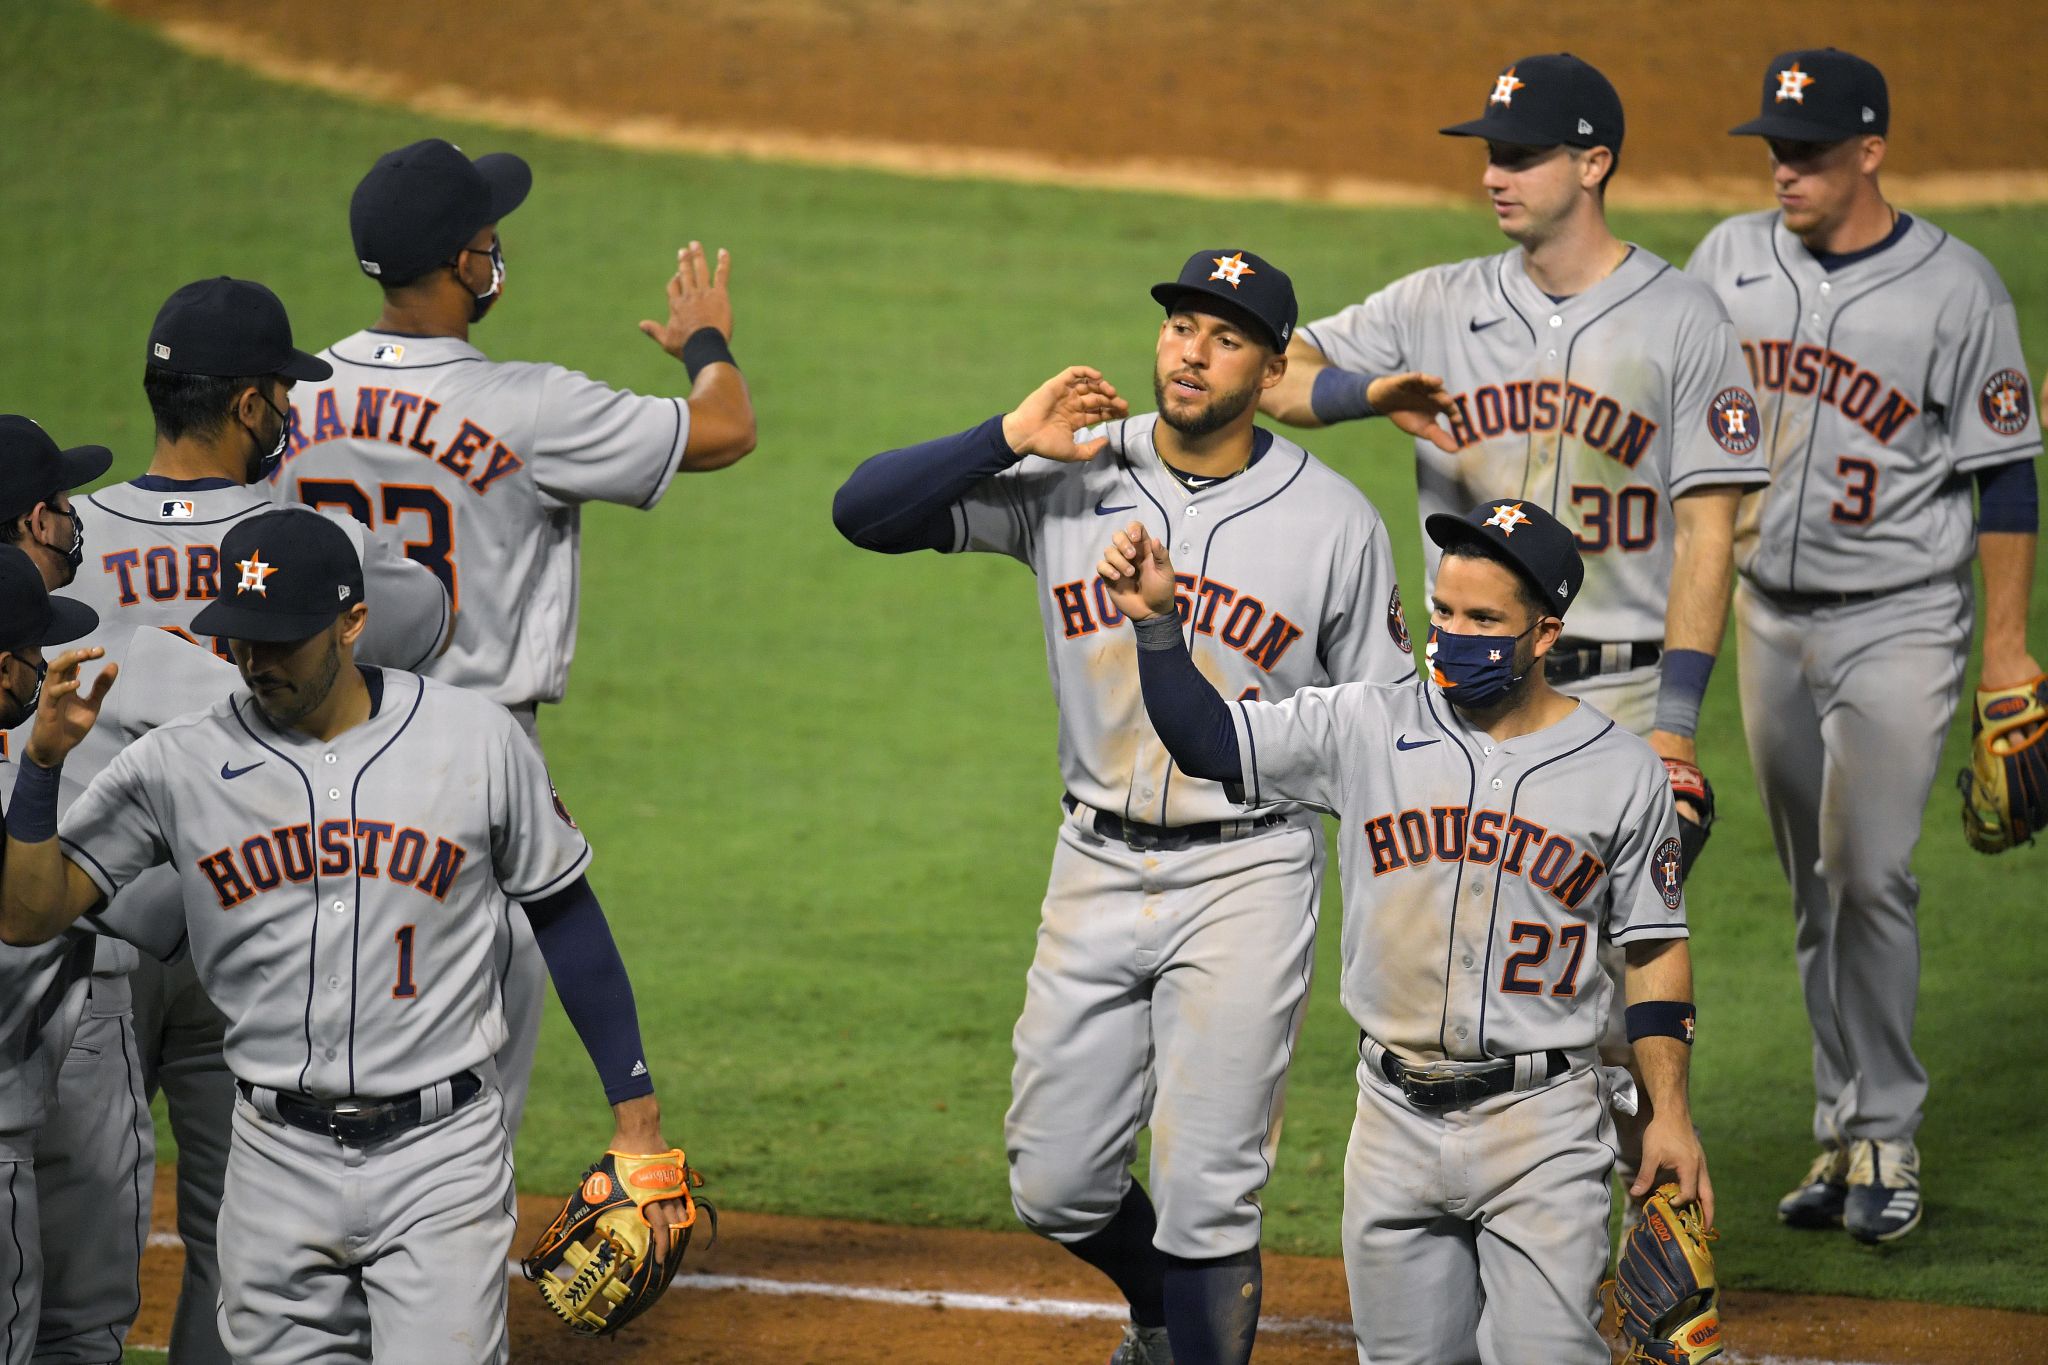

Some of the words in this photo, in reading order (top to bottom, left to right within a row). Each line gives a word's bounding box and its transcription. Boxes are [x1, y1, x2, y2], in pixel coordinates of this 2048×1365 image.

[1490, 75, 1519, 103] H
[1776, 71, 1807, 103] H
[1211, 256, 1250, 285] H
[268, 386, 524, 496] RANTLEY
[1450, 379, 1660, 471] HOUSTON
[1487, 504, 1527, 533] H
[1571, 485, 1658, 554] 30
[1831, 455, 1878, 526] 3
[238, 560, 270, 592] H
[1052, 572, 1304, 673] HOSTON
[197, 818, 468, 911] HOUSTON
[1364, 805, 1607, 912] HOUSTON
[391, 924, 417, 999] 1
[1501, 920, 1588, 997] 27
